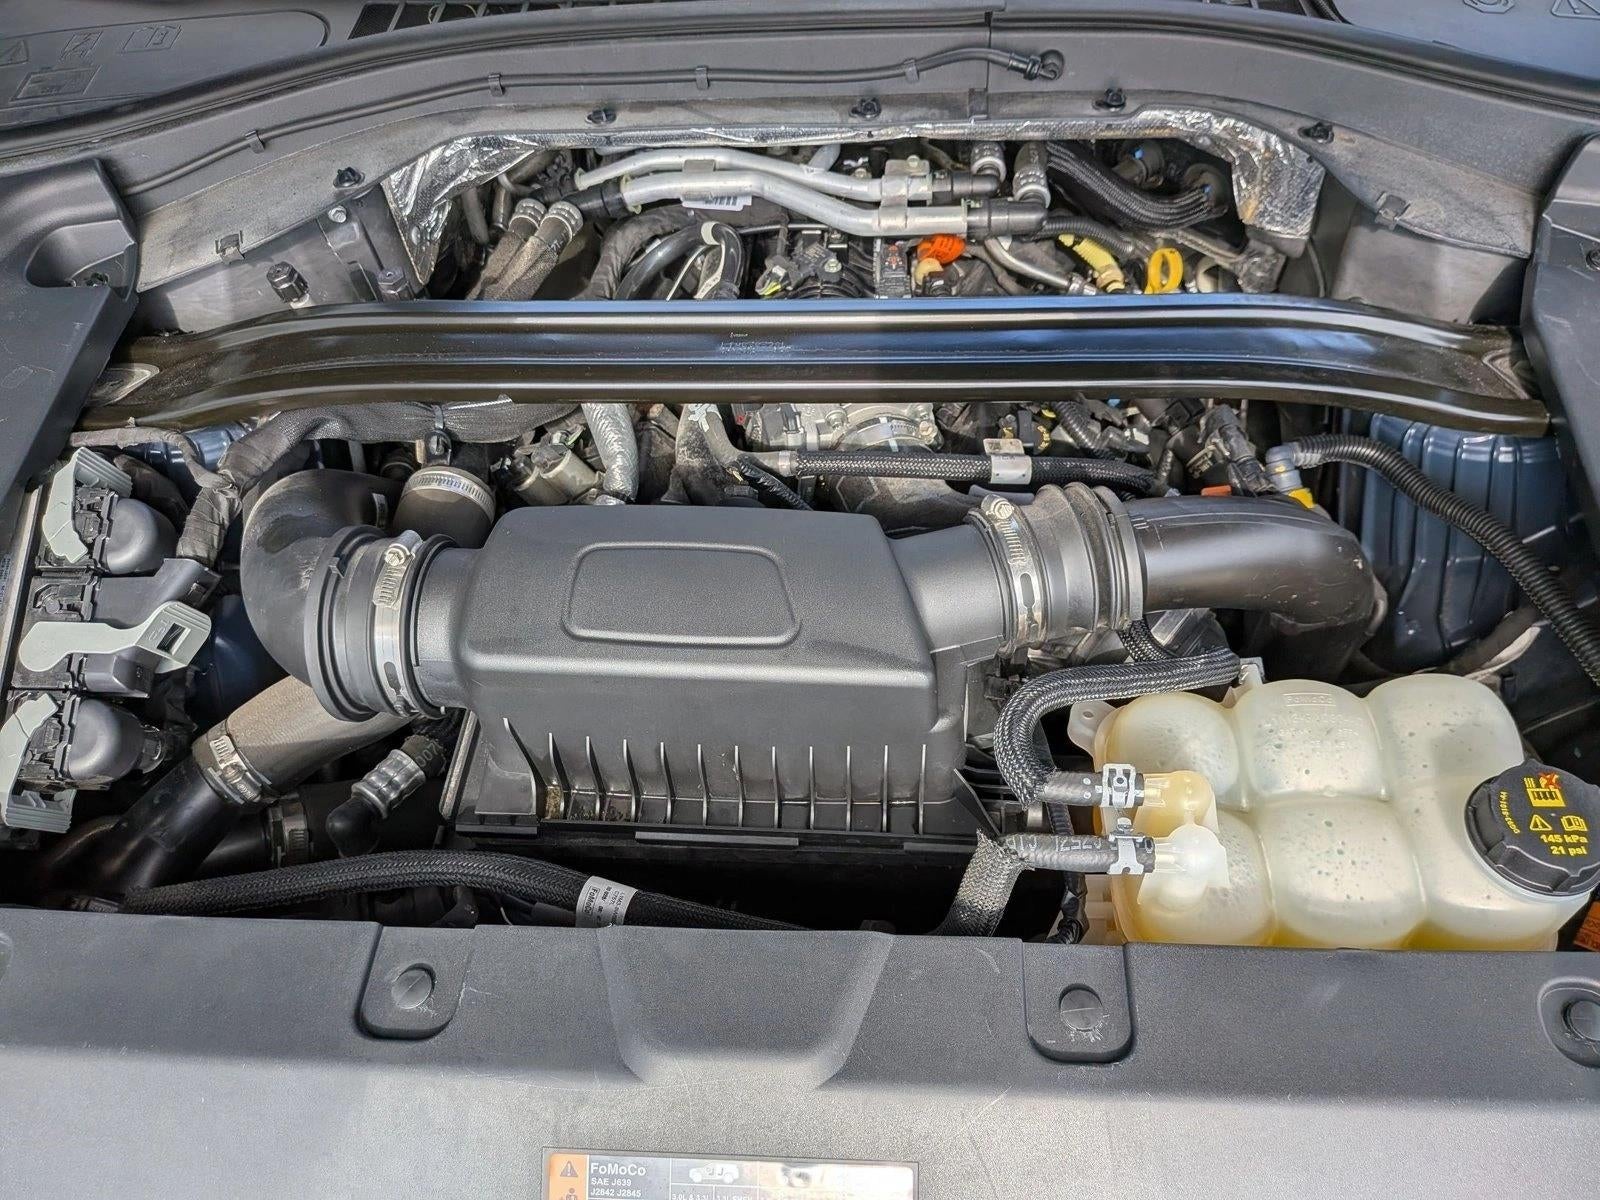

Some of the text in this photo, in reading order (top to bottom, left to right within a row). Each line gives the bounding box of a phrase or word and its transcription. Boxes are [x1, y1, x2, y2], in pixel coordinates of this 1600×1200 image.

[1540, 834, 1588, 843] 145 kPa
[1550, 845, 1588, 857] 21 psi
[590, 1162, 647, 1176] FoMoCo
[591, 1177, 632, 1187] SAE J639
[590, 1188, 642, 1198] J2842 J2845
